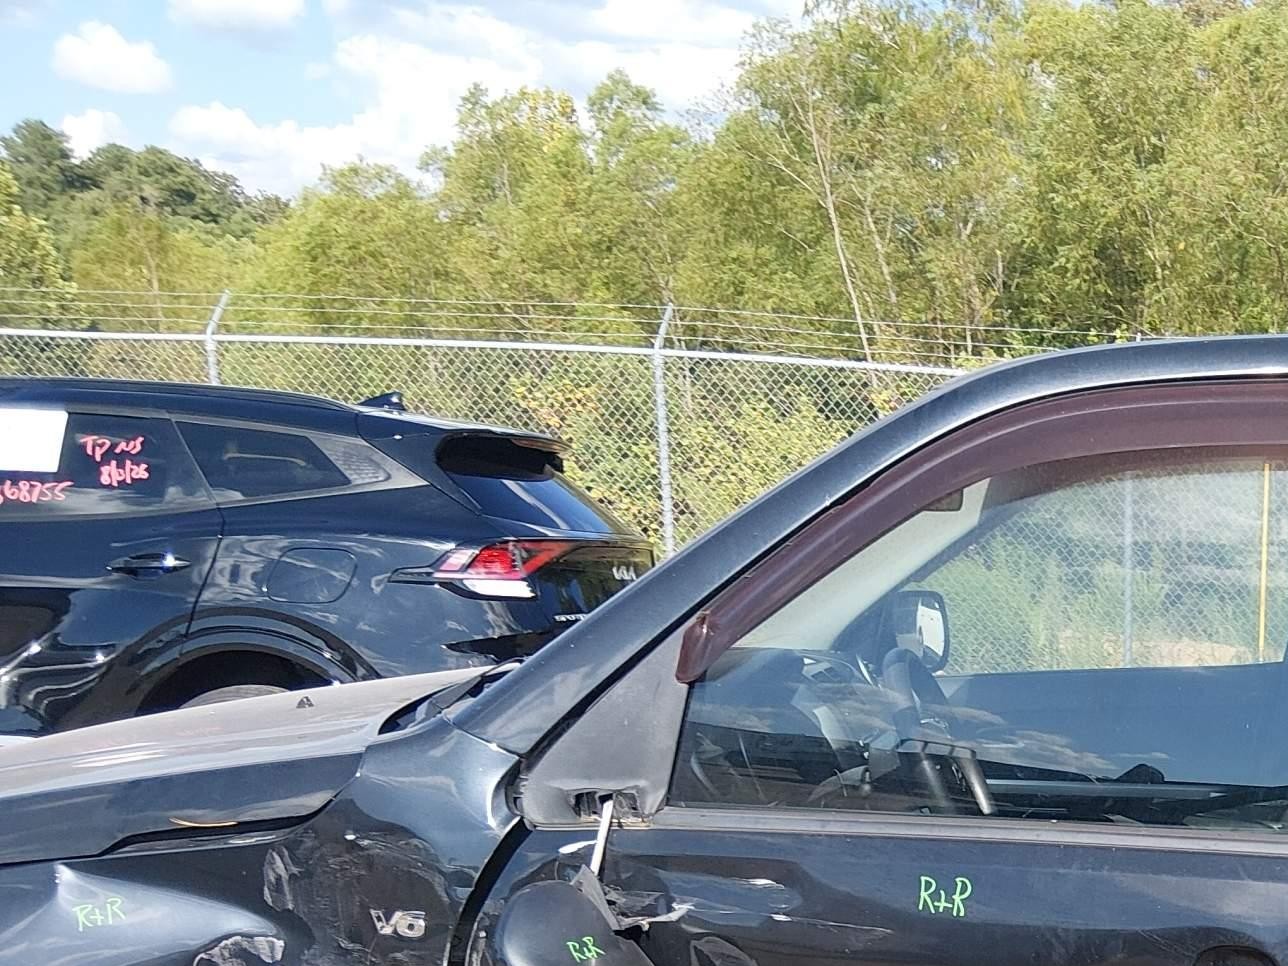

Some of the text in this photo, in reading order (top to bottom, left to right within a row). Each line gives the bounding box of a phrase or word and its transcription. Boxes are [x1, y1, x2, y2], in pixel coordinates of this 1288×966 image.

[80, 435, 111, 462] TP
[918, 875, 972, 917] R+R
[72, 897, 126, 932] R+R
[369, 909, 426, 937] V6
